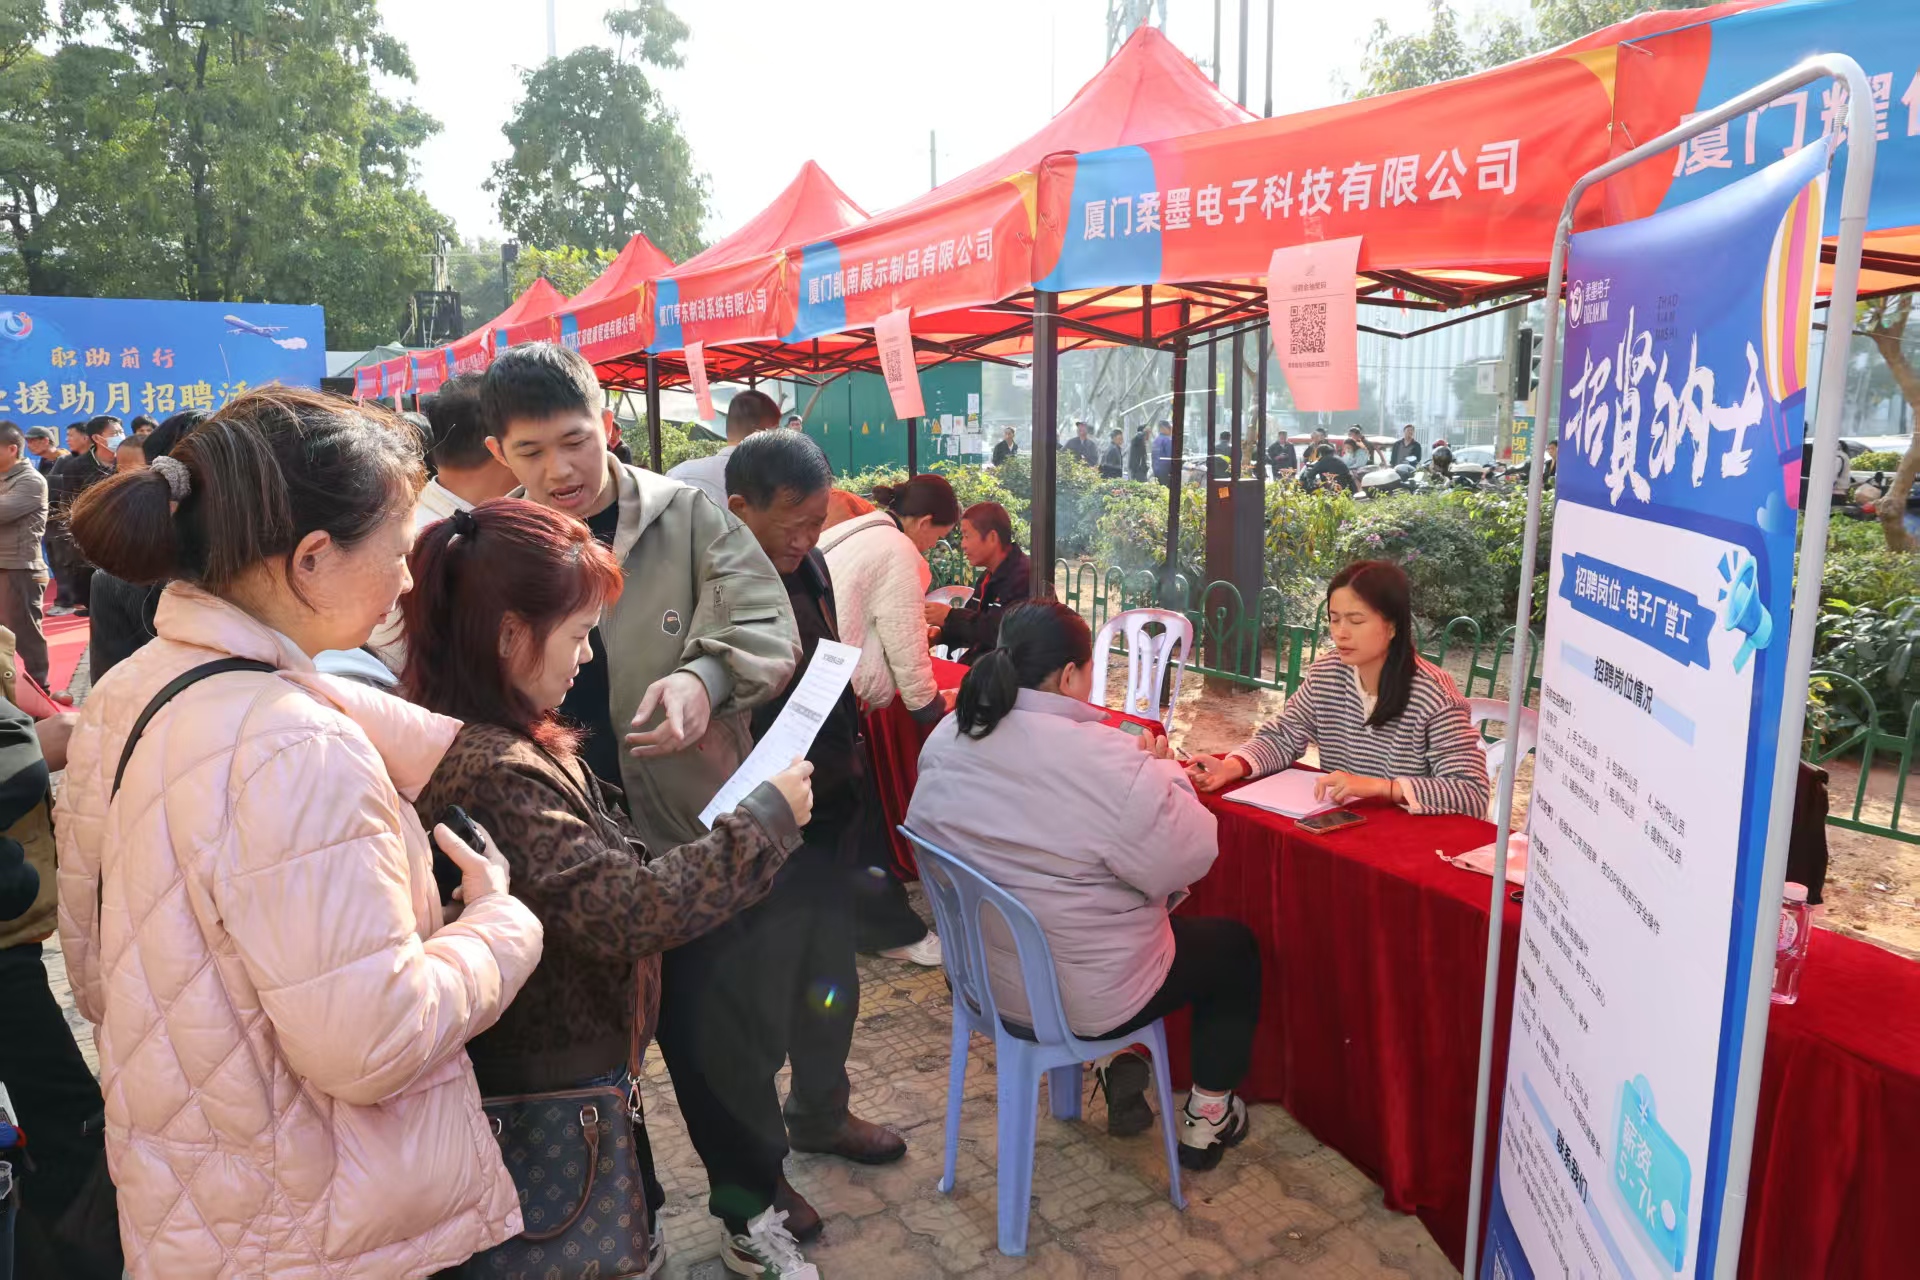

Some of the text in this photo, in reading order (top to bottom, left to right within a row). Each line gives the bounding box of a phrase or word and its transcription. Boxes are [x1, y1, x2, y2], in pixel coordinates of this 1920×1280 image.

[1084, 139, 1519, 240] 厦门柔墨电子科技有限公司
[808, 227, 993, 305] 厦门凯南展示制品有限公司
[51, 346, 175, 369] 职助前行
[1575, 565, 1692, 643] 招聘岗位-电子厂普工
[1594, 656, 1653, 714] 招聘岗位情况
[1556, 1129, 1586, 1202] 联系我们
[1623, 1114, 1652, 1180] 薪资
